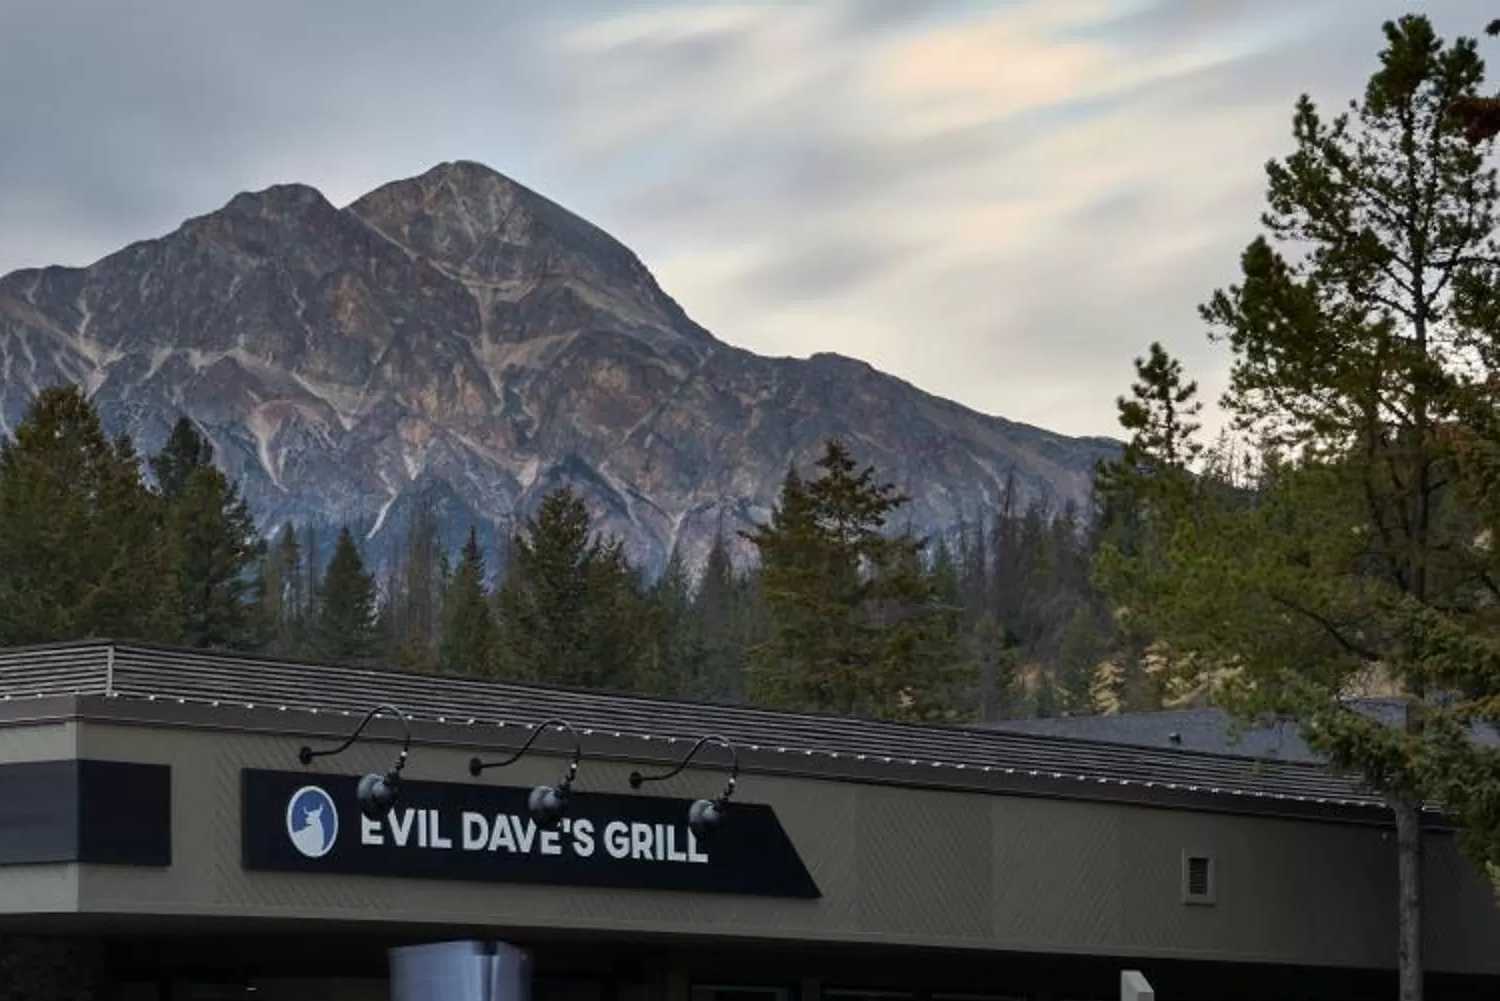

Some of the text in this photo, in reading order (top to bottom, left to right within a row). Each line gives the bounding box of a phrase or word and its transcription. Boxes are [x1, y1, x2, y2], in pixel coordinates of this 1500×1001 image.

[360, 807, 709, 863] EVIL DAVE'S GRILL
